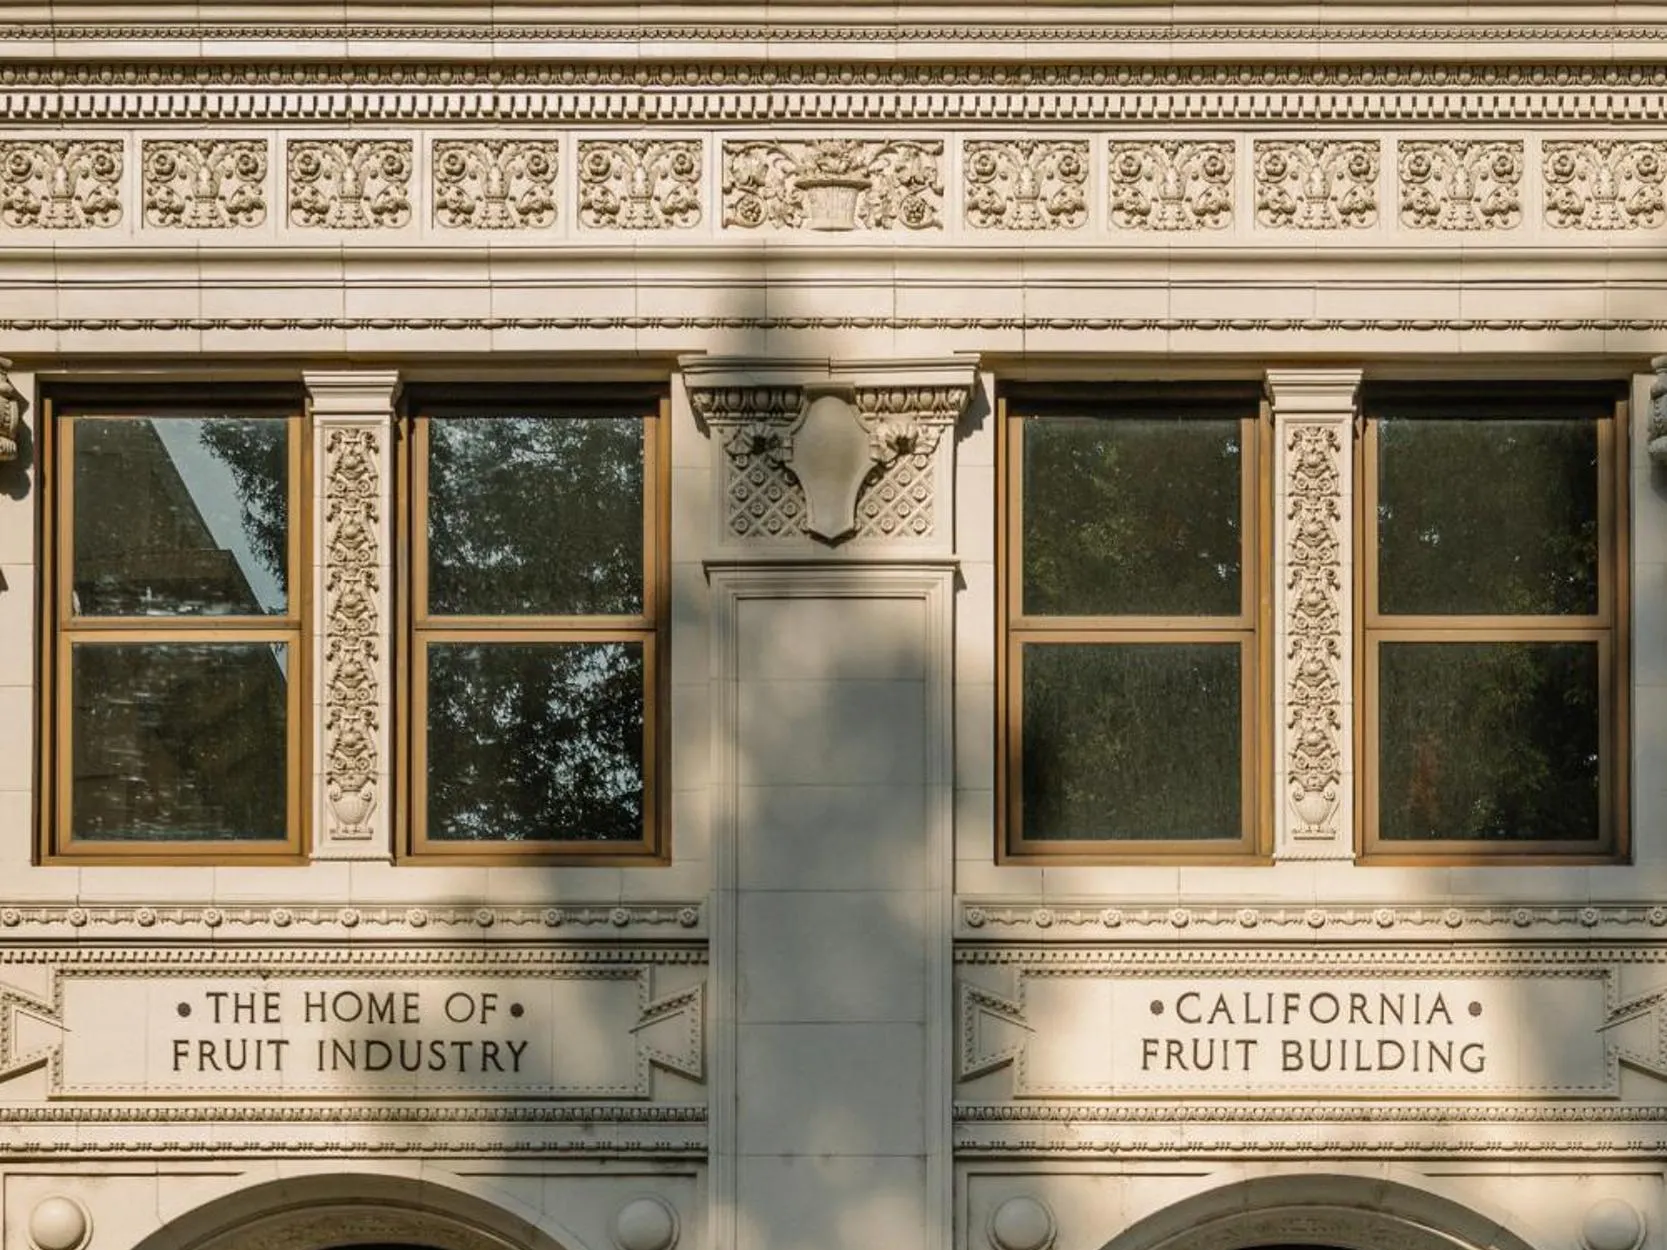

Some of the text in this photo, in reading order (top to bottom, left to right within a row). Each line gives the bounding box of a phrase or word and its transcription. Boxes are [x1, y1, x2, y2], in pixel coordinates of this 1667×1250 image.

[205, 990, 498, 1025] THE HOME OF
[1175, 991, 1454, 1026] CALIFORNIA
[172, 1038, 529, 1073] FRUIT INDUSTRY
[1141, 1038, 1486, 1074] FRUIT BUILDING
